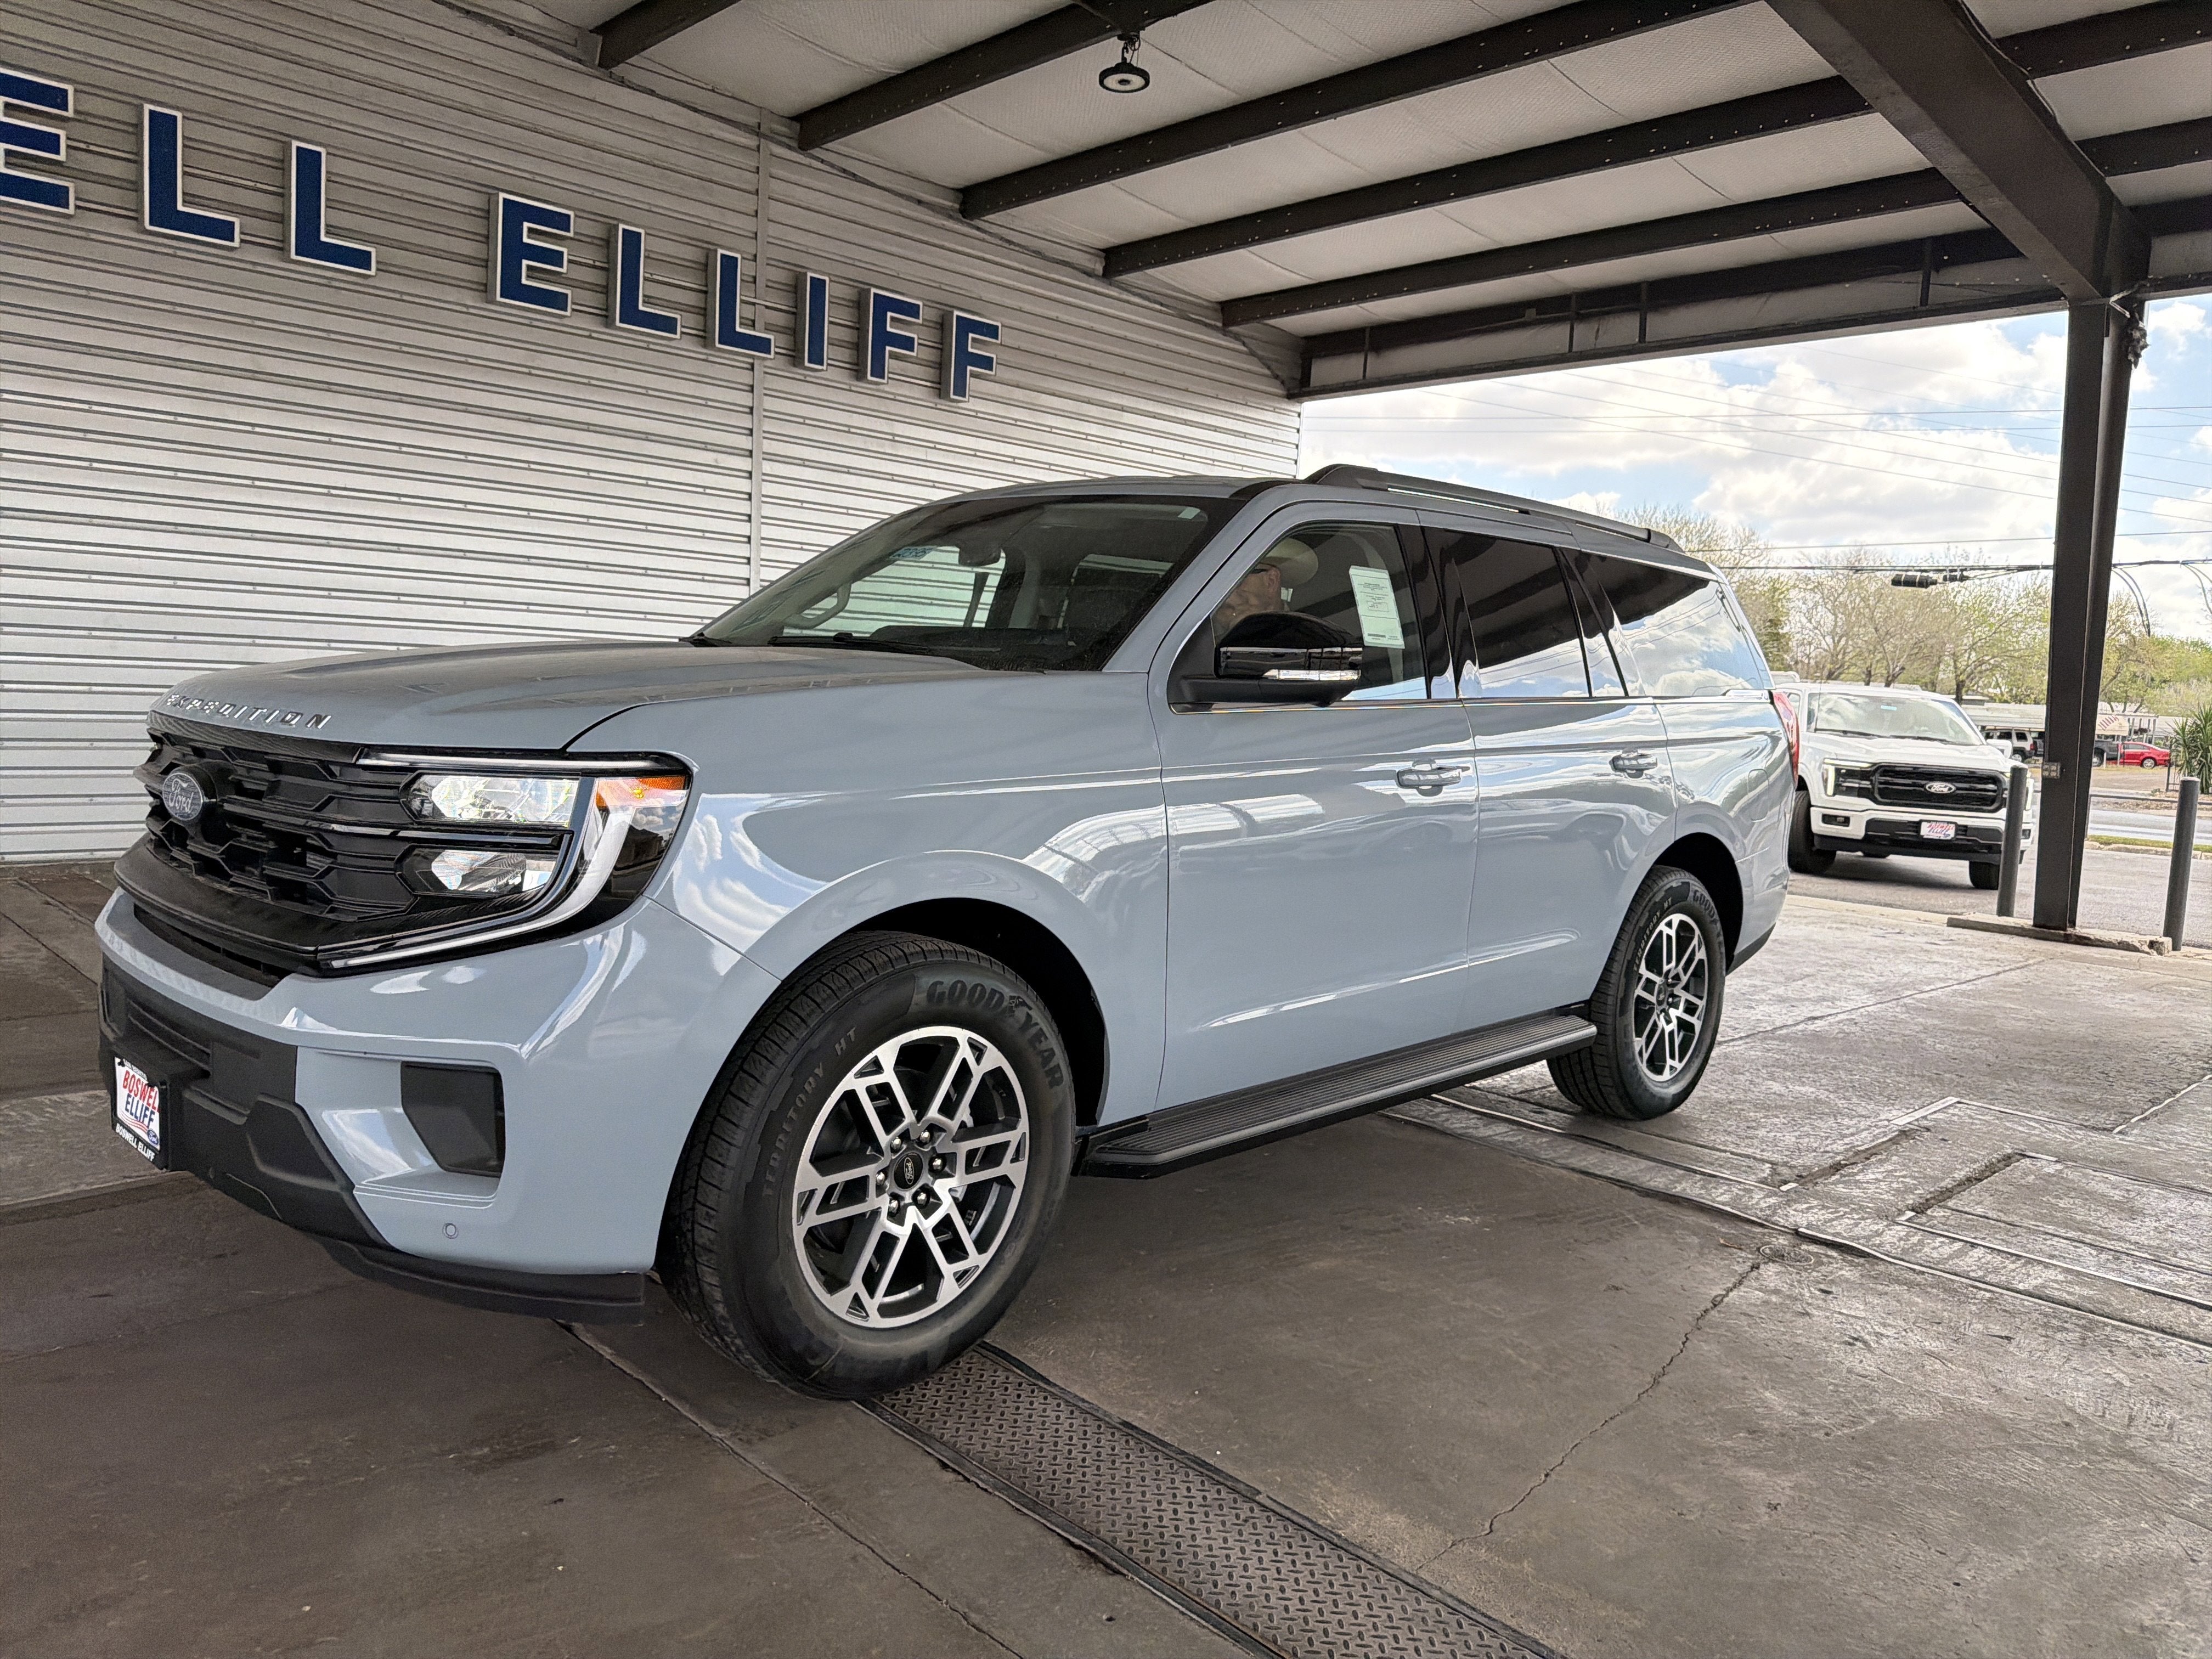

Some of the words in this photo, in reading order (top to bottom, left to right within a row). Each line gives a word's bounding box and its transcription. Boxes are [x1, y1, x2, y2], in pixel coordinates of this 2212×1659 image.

[494, 191, 1002, 402] ELLIFF
[167, 693, 332, 729] EXPEDITION
[926, 979, 1064, 1090] GOODYEAR
[123, 1070, 159, 1114] BOSWEL
[125, 1092, 155, 1128] ELLIFF
[763, 1062, 824, 1197] TERRITORY
[834, 1026, 856, 1057] HT
[116, 1122, 137, 1149] BOSWELL
[137, 1141, 155, 1162] ELLIFF
